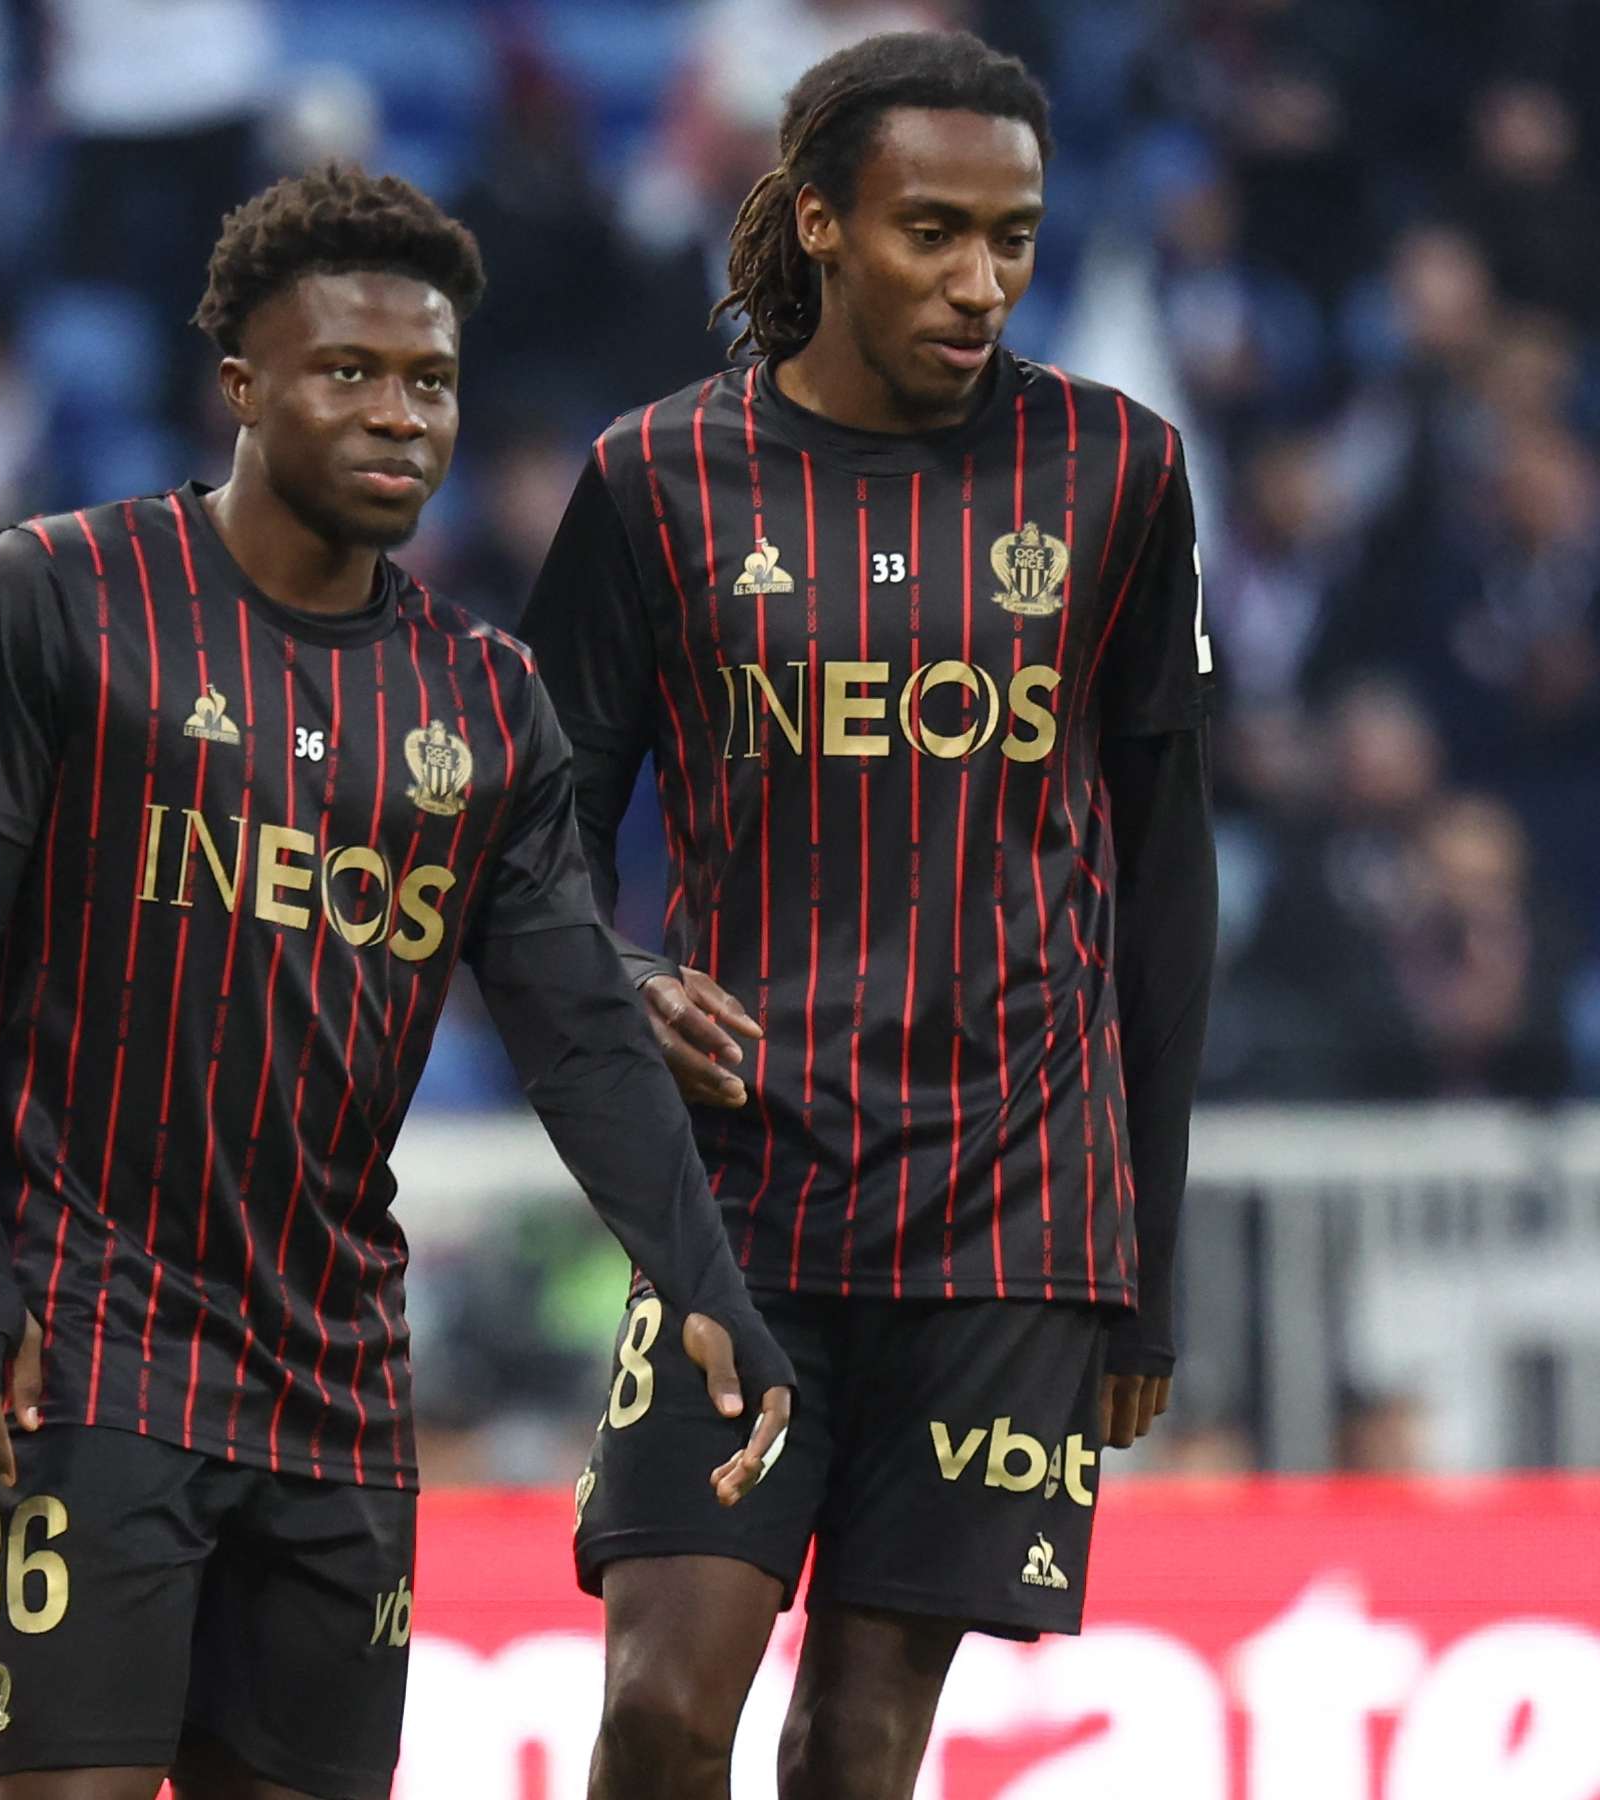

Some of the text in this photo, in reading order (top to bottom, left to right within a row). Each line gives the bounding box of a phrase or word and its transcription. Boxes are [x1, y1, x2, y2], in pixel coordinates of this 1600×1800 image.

[872, 552, 906, 583] 33
[1014, 547, 1046, 560] OGC
[1014, 559, 1046, 570] NICE
[733, 584, 744, 595] LE
[716, 658, 1063, 764] INEOS
[294, 727, 325, 762] 36
[135, 803, 458, 963] INEOS
[597, 1298, 663, 1426] 8
[929, 1416, 1096, 1507] vbet
